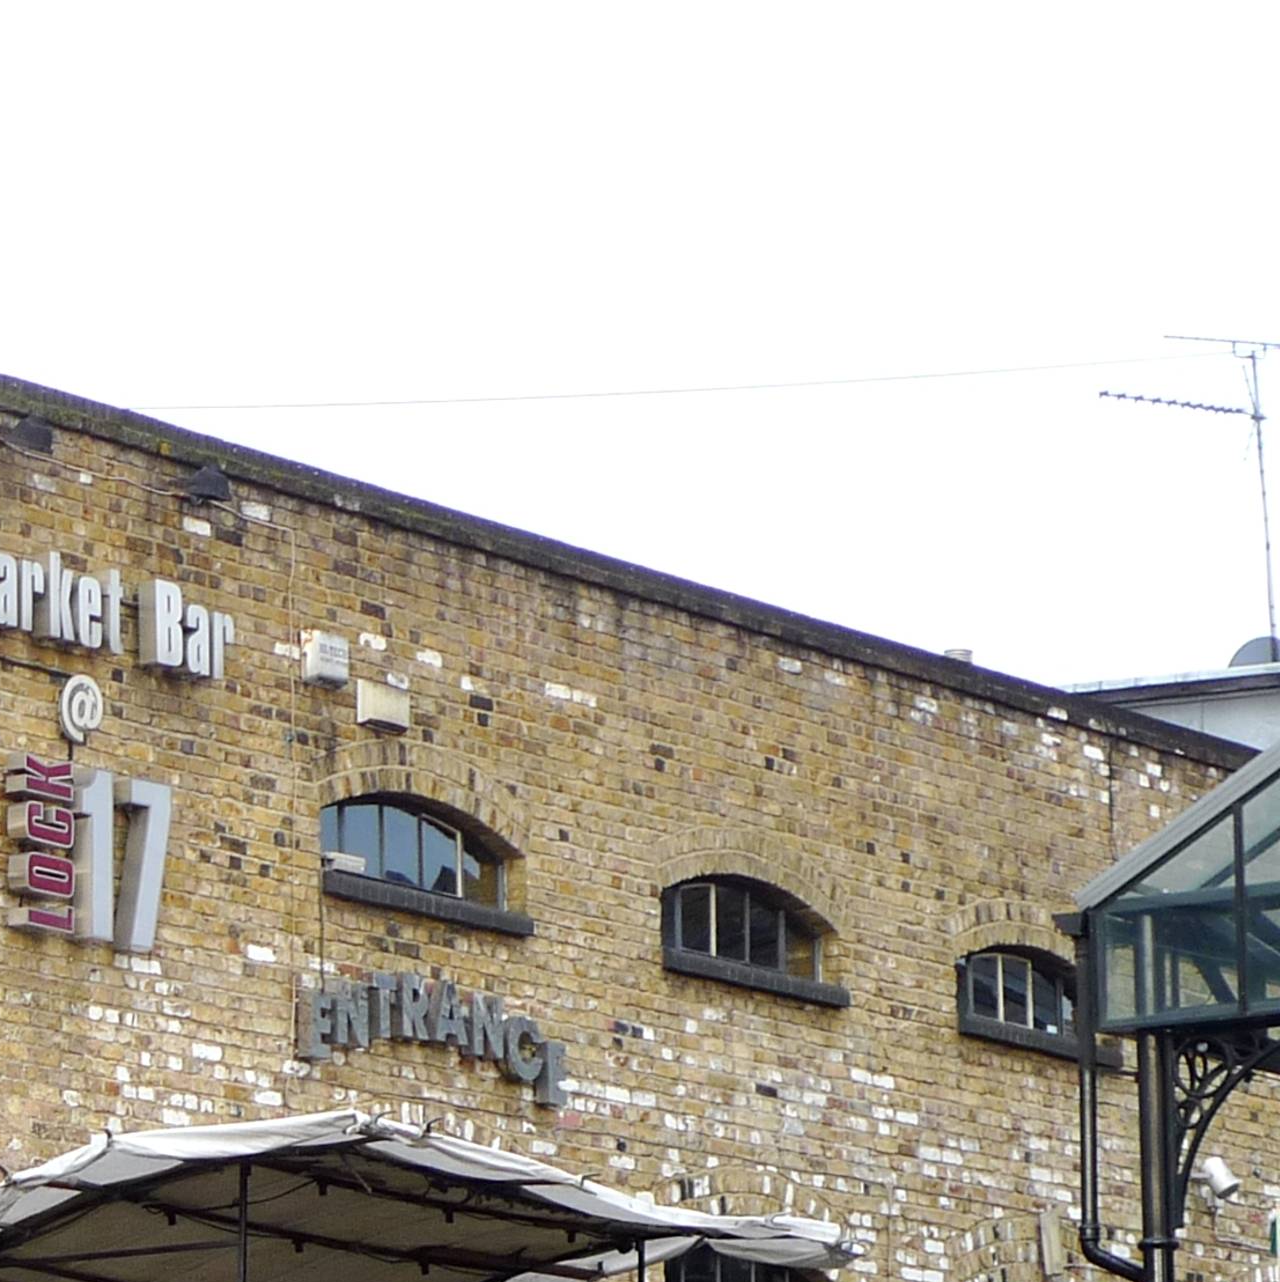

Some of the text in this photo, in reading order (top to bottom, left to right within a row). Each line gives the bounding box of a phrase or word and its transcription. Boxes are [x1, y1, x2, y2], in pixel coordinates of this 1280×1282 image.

[141, 578, 235, 681] Bar
[58, 675, 104, 744] @
[6, 754, 172, 953] LOCK 17
[297, 972, 569, 1109] ENTRANCE
